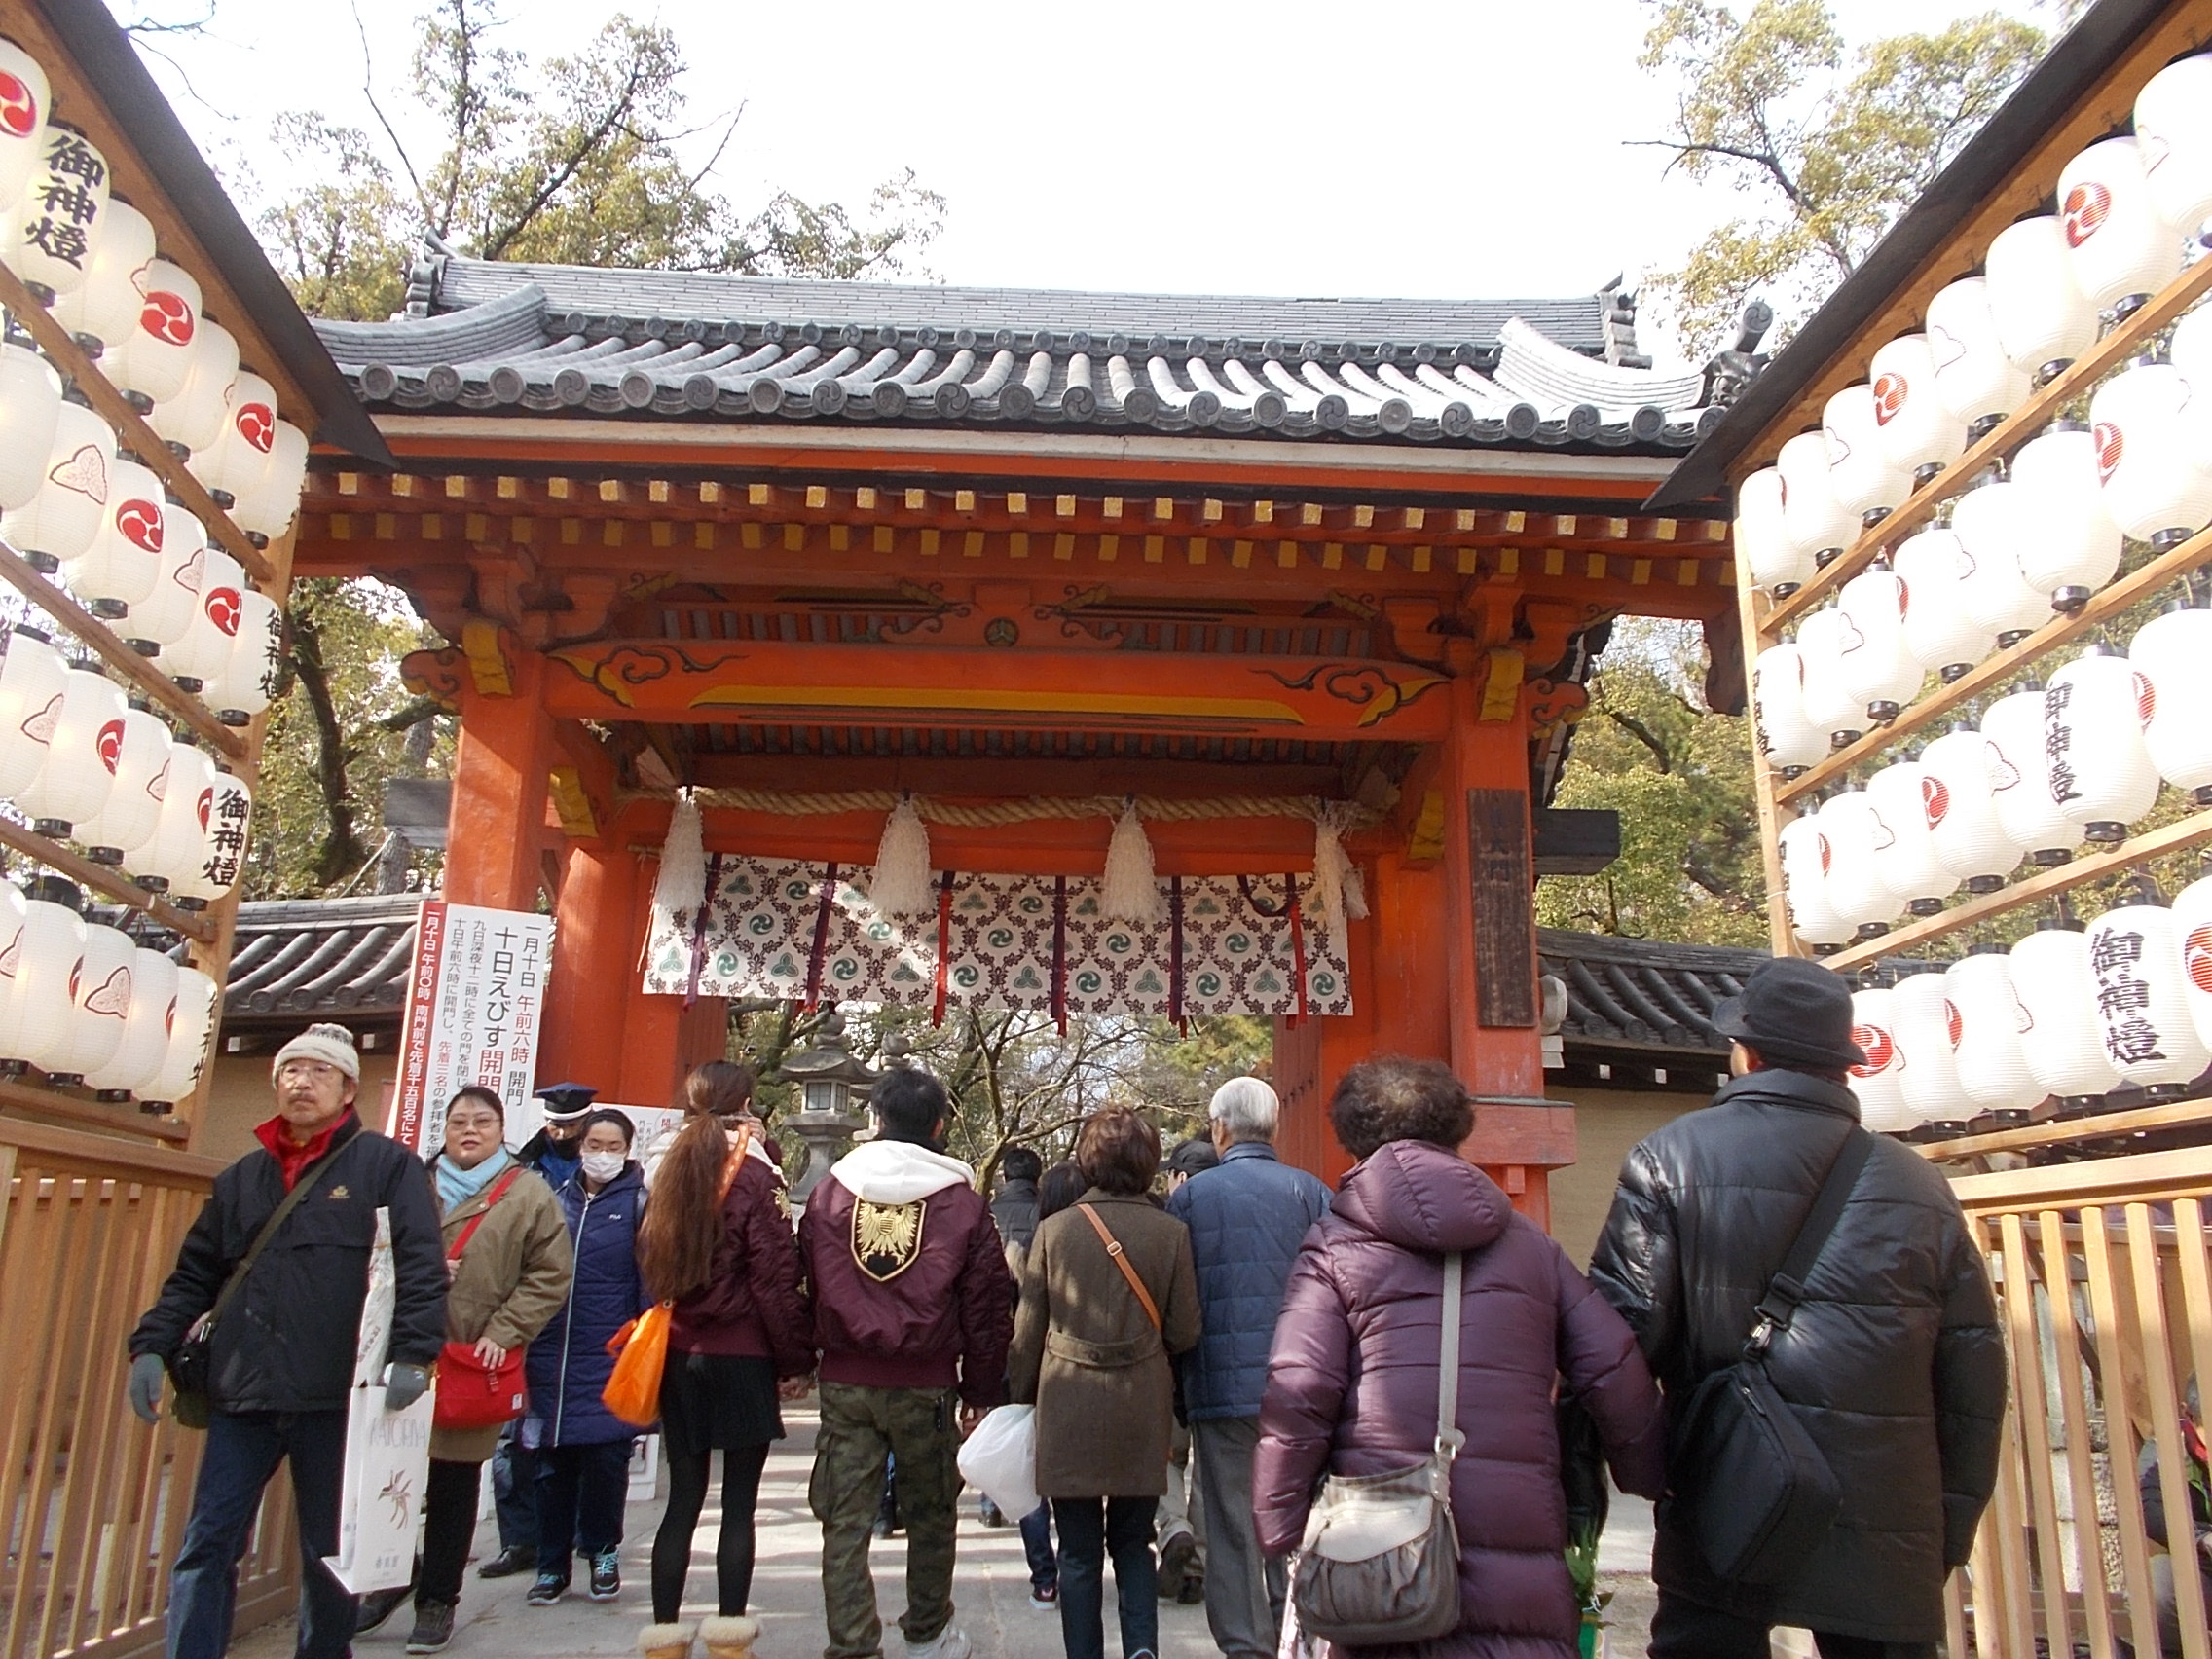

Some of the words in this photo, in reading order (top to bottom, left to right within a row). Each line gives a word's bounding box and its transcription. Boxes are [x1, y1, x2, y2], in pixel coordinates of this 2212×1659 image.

[24, 134, 104, 271] 御神燈
[202, 788, 250, 887] 御神燈
[423, 910, 441, 951] 一月十日
[520, 925, 542, 988] 一月十日
[510, 994, 535, 1064] 午前六時
[2090, 927, 2167, 1065] 御神燈
[400, 1004, 430, 1145] 南門前で先着千五百名にて
[505, 1070, 527, 1107] 開門
